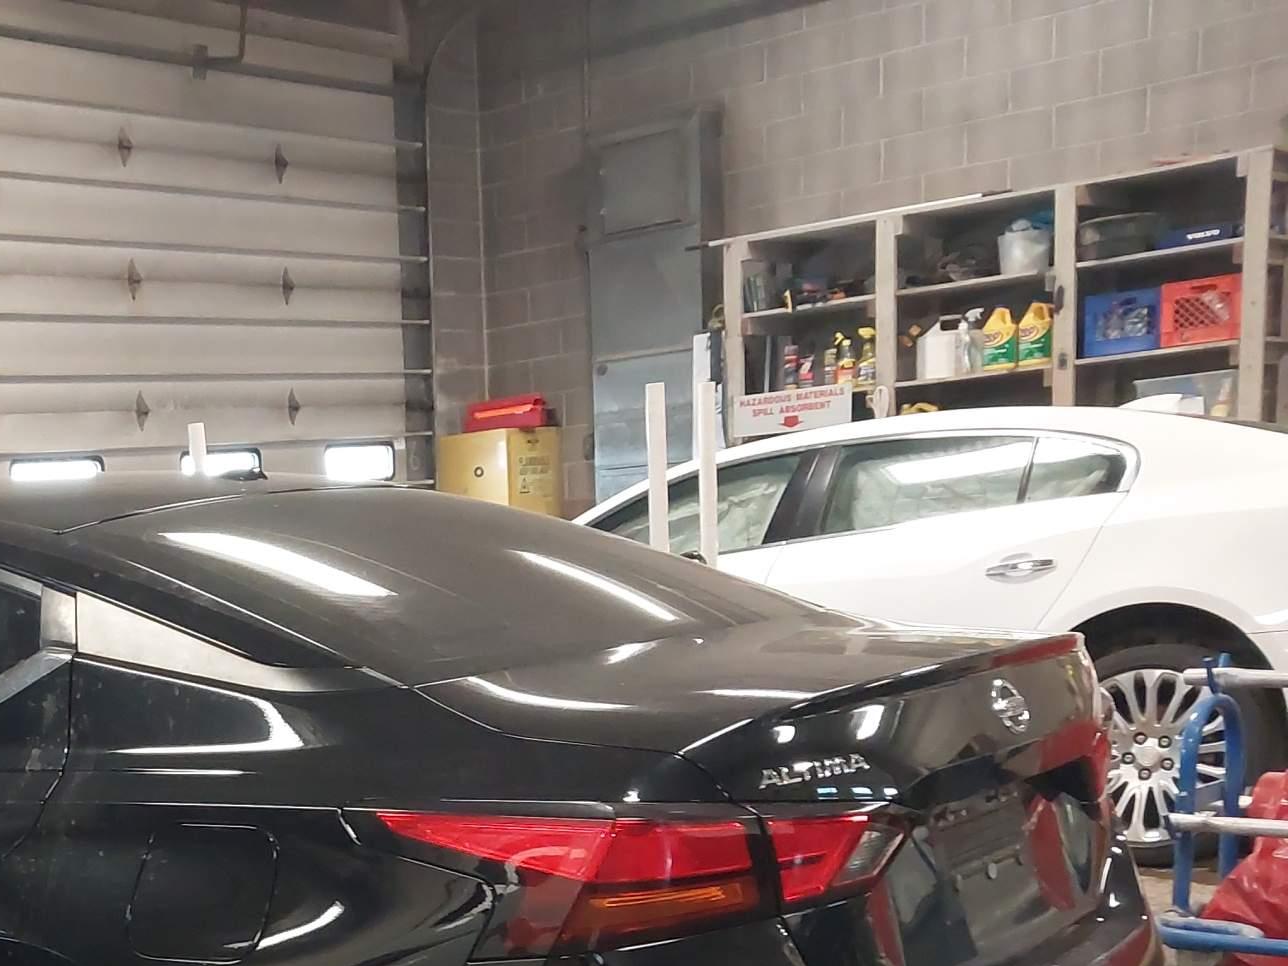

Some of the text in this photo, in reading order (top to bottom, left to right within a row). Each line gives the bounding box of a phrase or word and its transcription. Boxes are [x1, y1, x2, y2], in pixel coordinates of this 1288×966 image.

[739, 386, 845, 408] HAZARDOUS MATERIALS
[752, 400, 832, 417] SPILL ABSORBENT
[758, 753, 871, 790] ALTIMA
